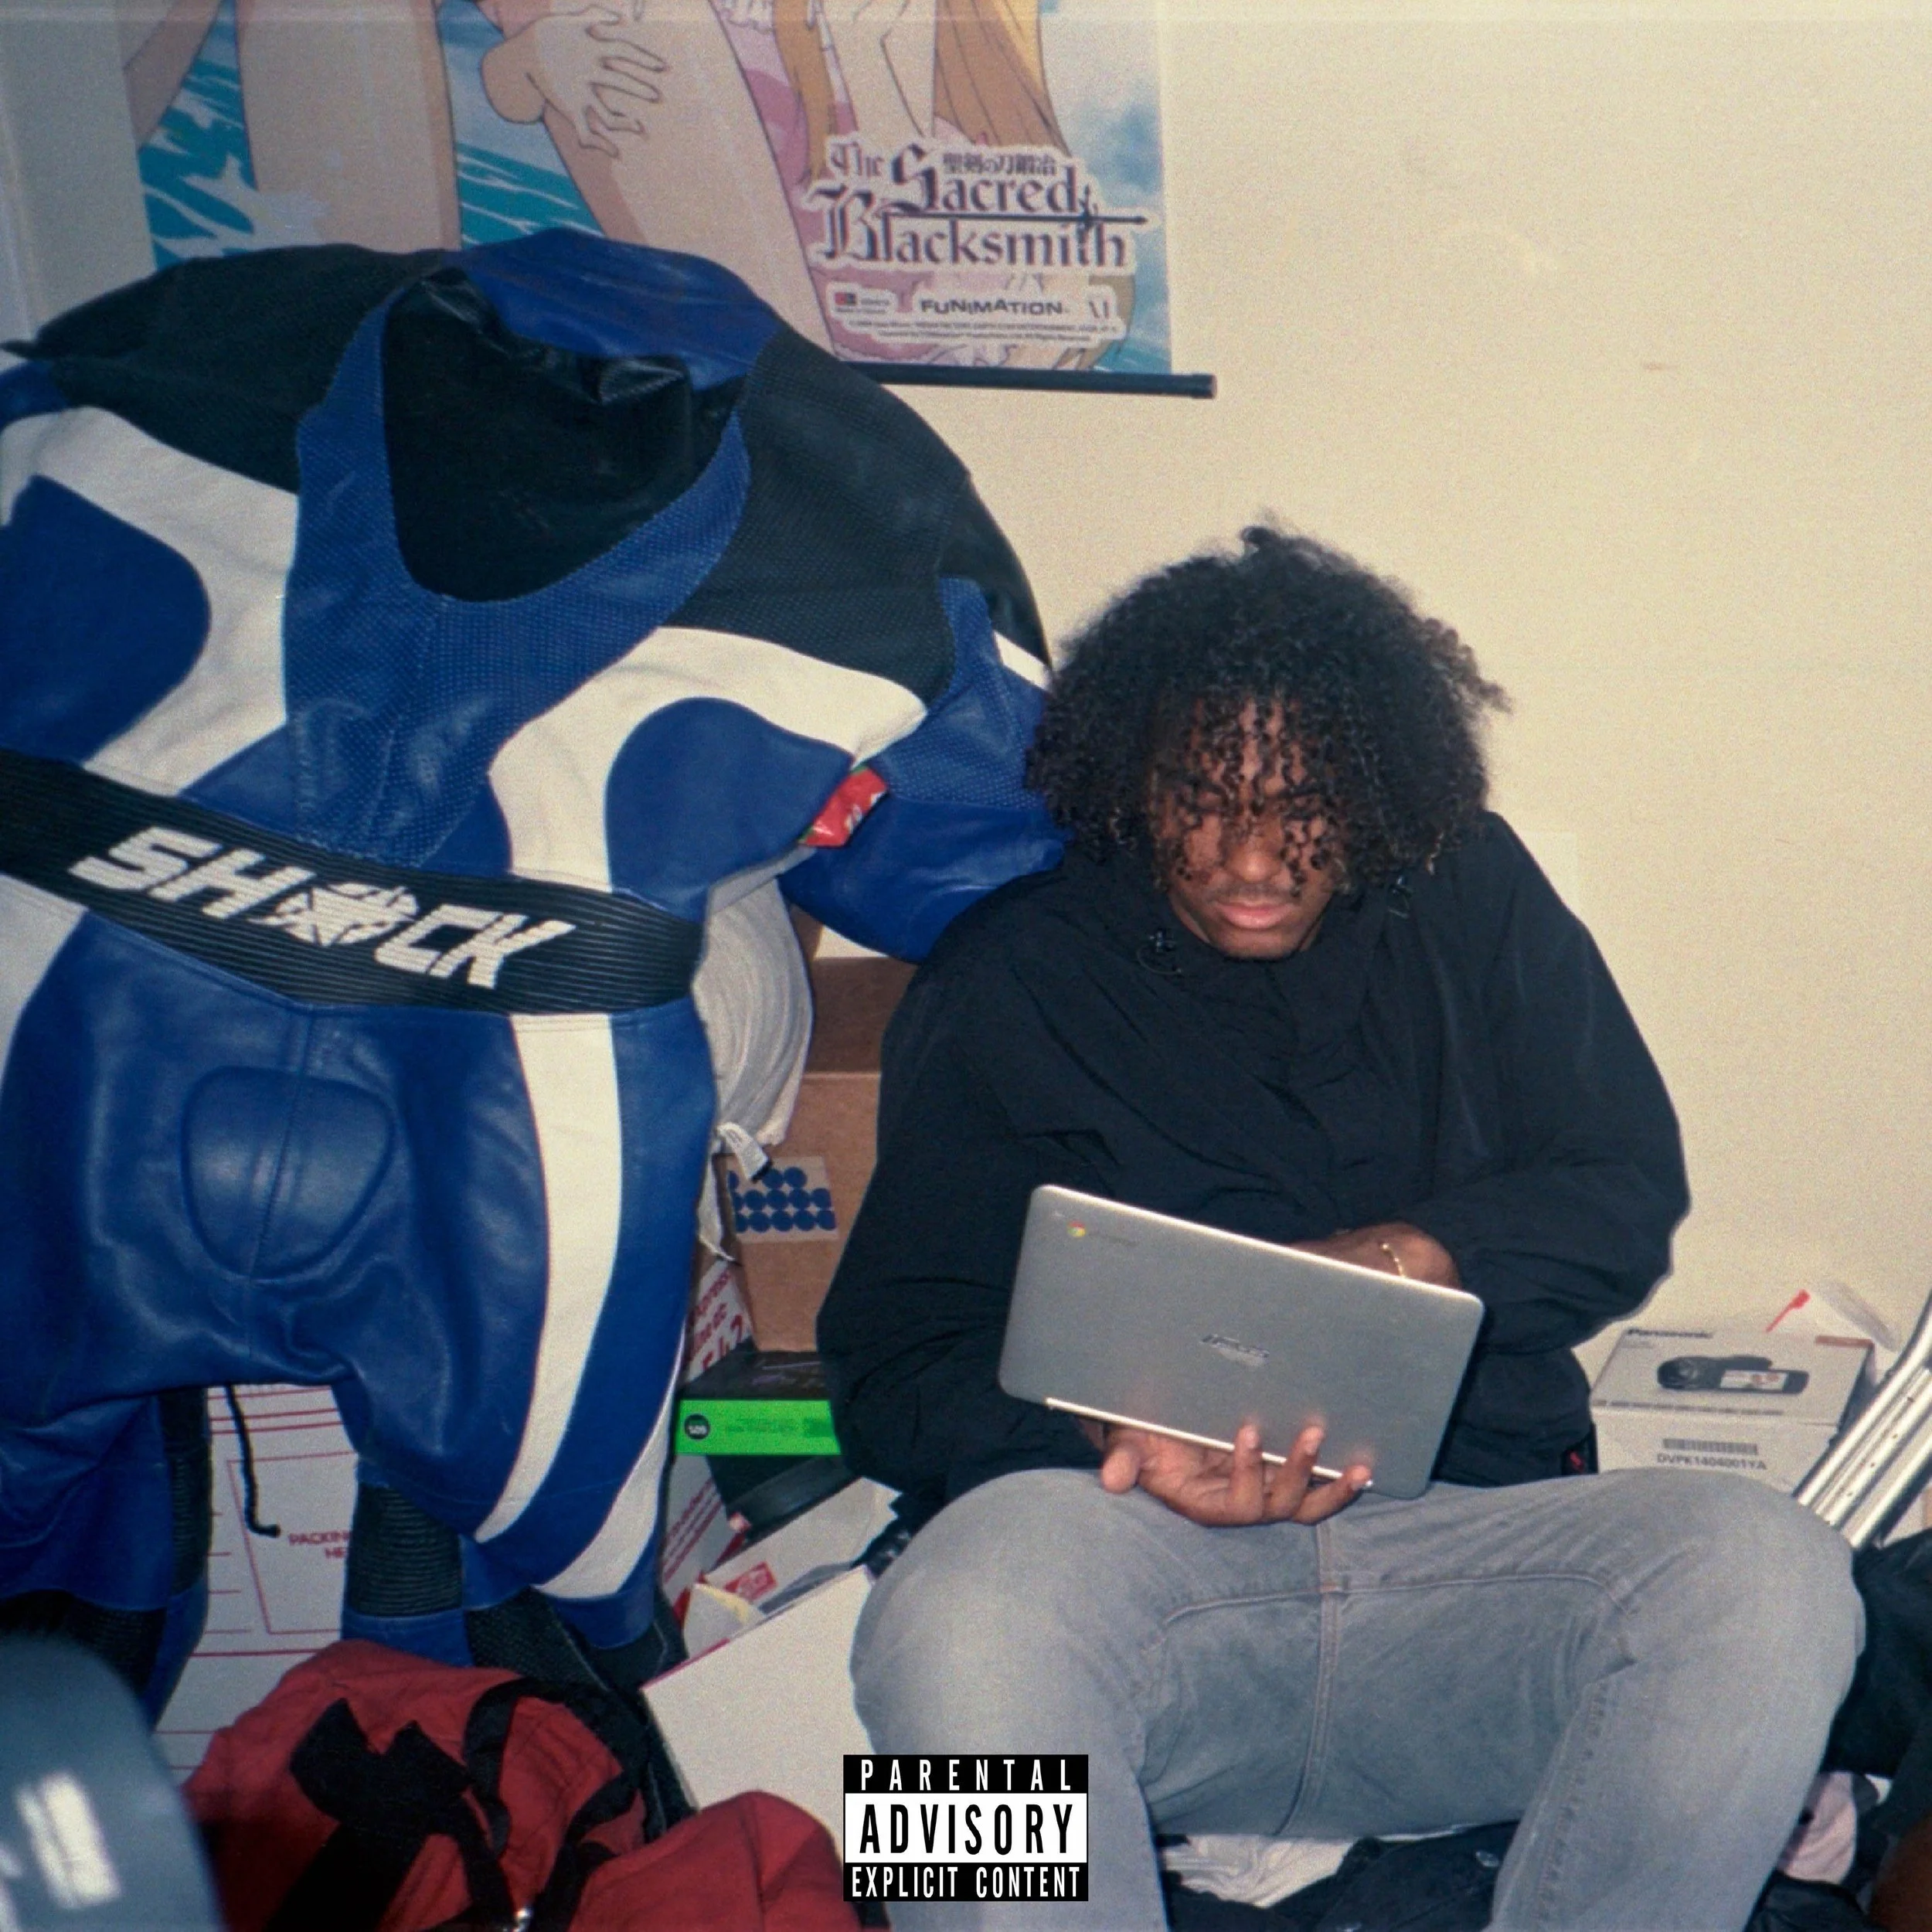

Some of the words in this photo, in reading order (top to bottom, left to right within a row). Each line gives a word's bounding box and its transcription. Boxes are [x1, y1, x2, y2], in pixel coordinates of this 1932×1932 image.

[830, 141, 885, 179] The
[882, 142, 1080, 213] Sacred
[809, 183, 1125, 266] Blacksmith
[288, 1531, 352, 1545] PACKIN
